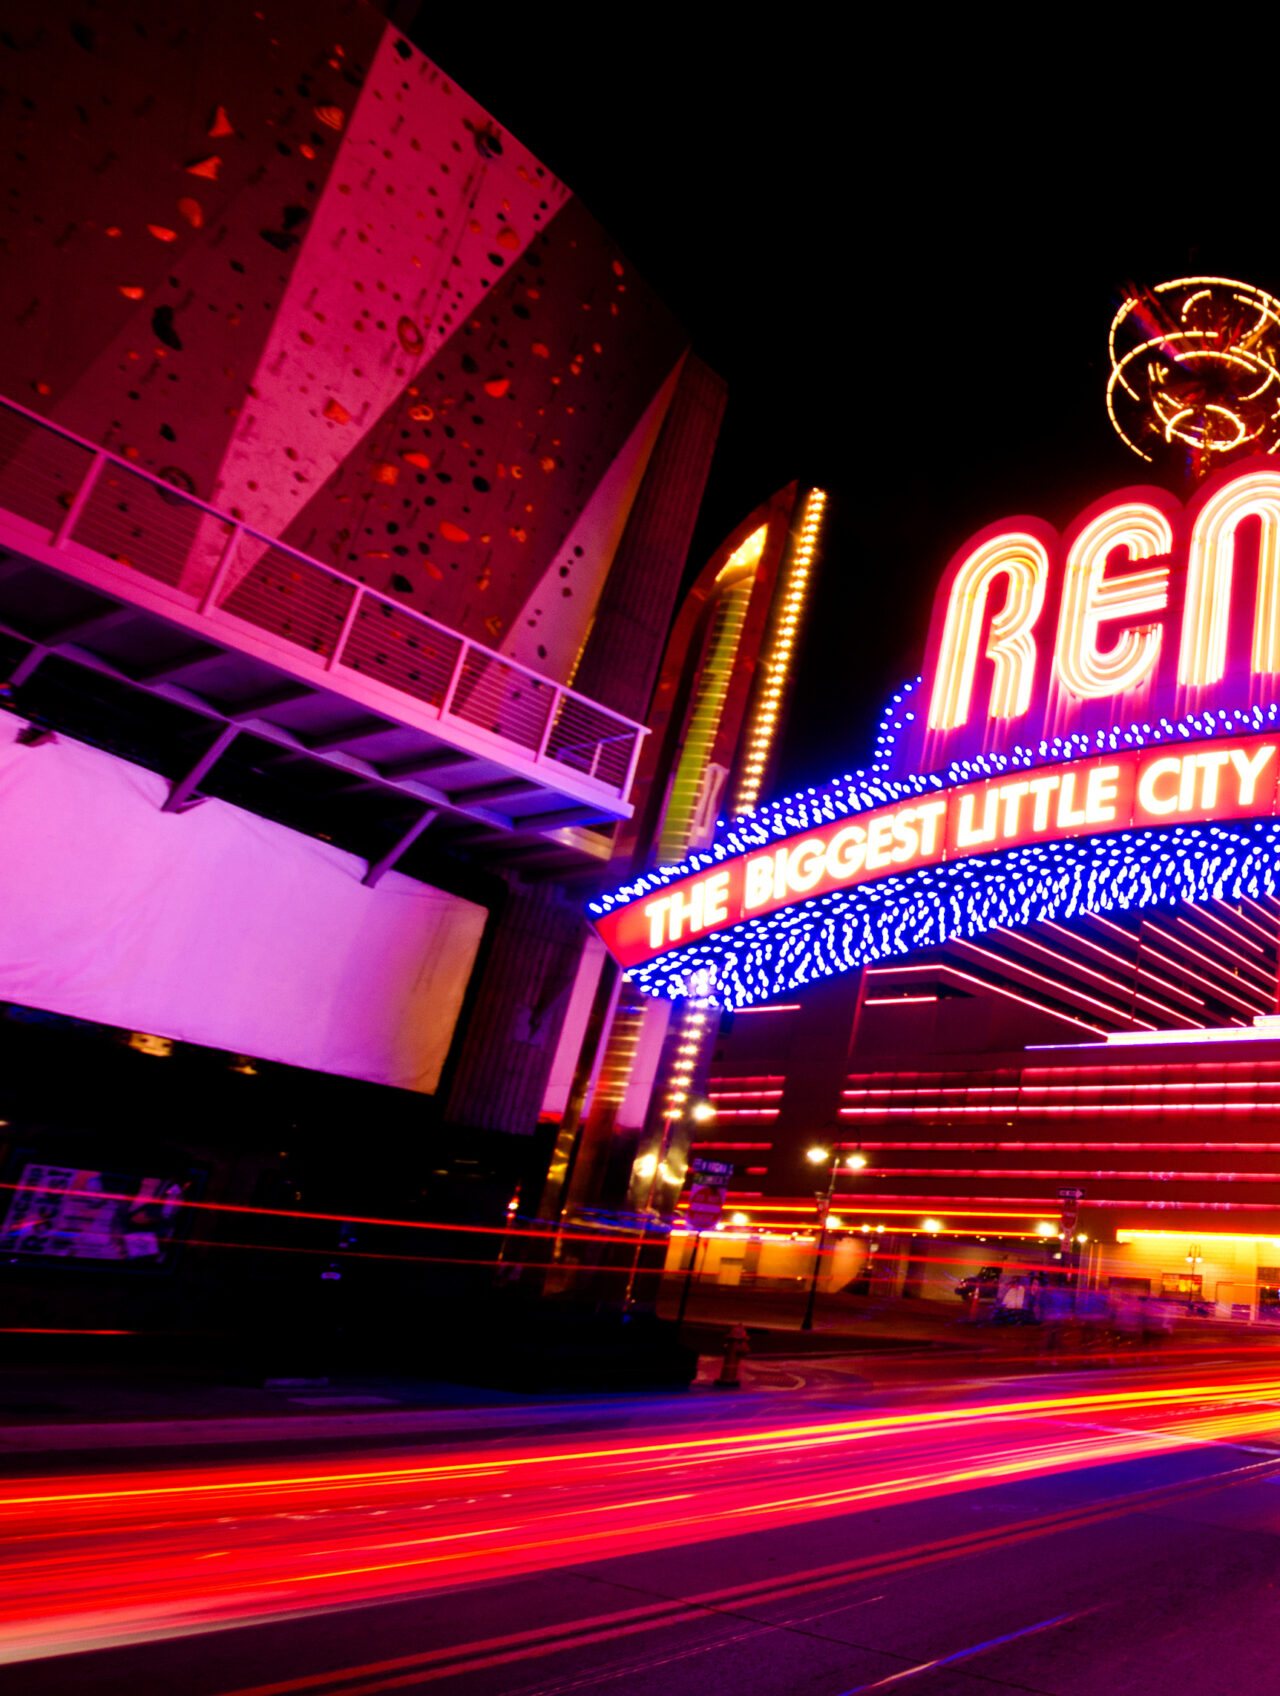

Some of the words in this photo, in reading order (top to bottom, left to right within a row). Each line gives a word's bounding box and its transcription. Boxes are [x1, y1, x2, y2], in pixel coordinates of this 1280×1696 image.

[645, 872, 729, 949] THE
[744, 801, 946, 911] BIGGEST
[956, 764, 1119, 848] LITTLE
[1138, 746, 1275, 815] CITY
